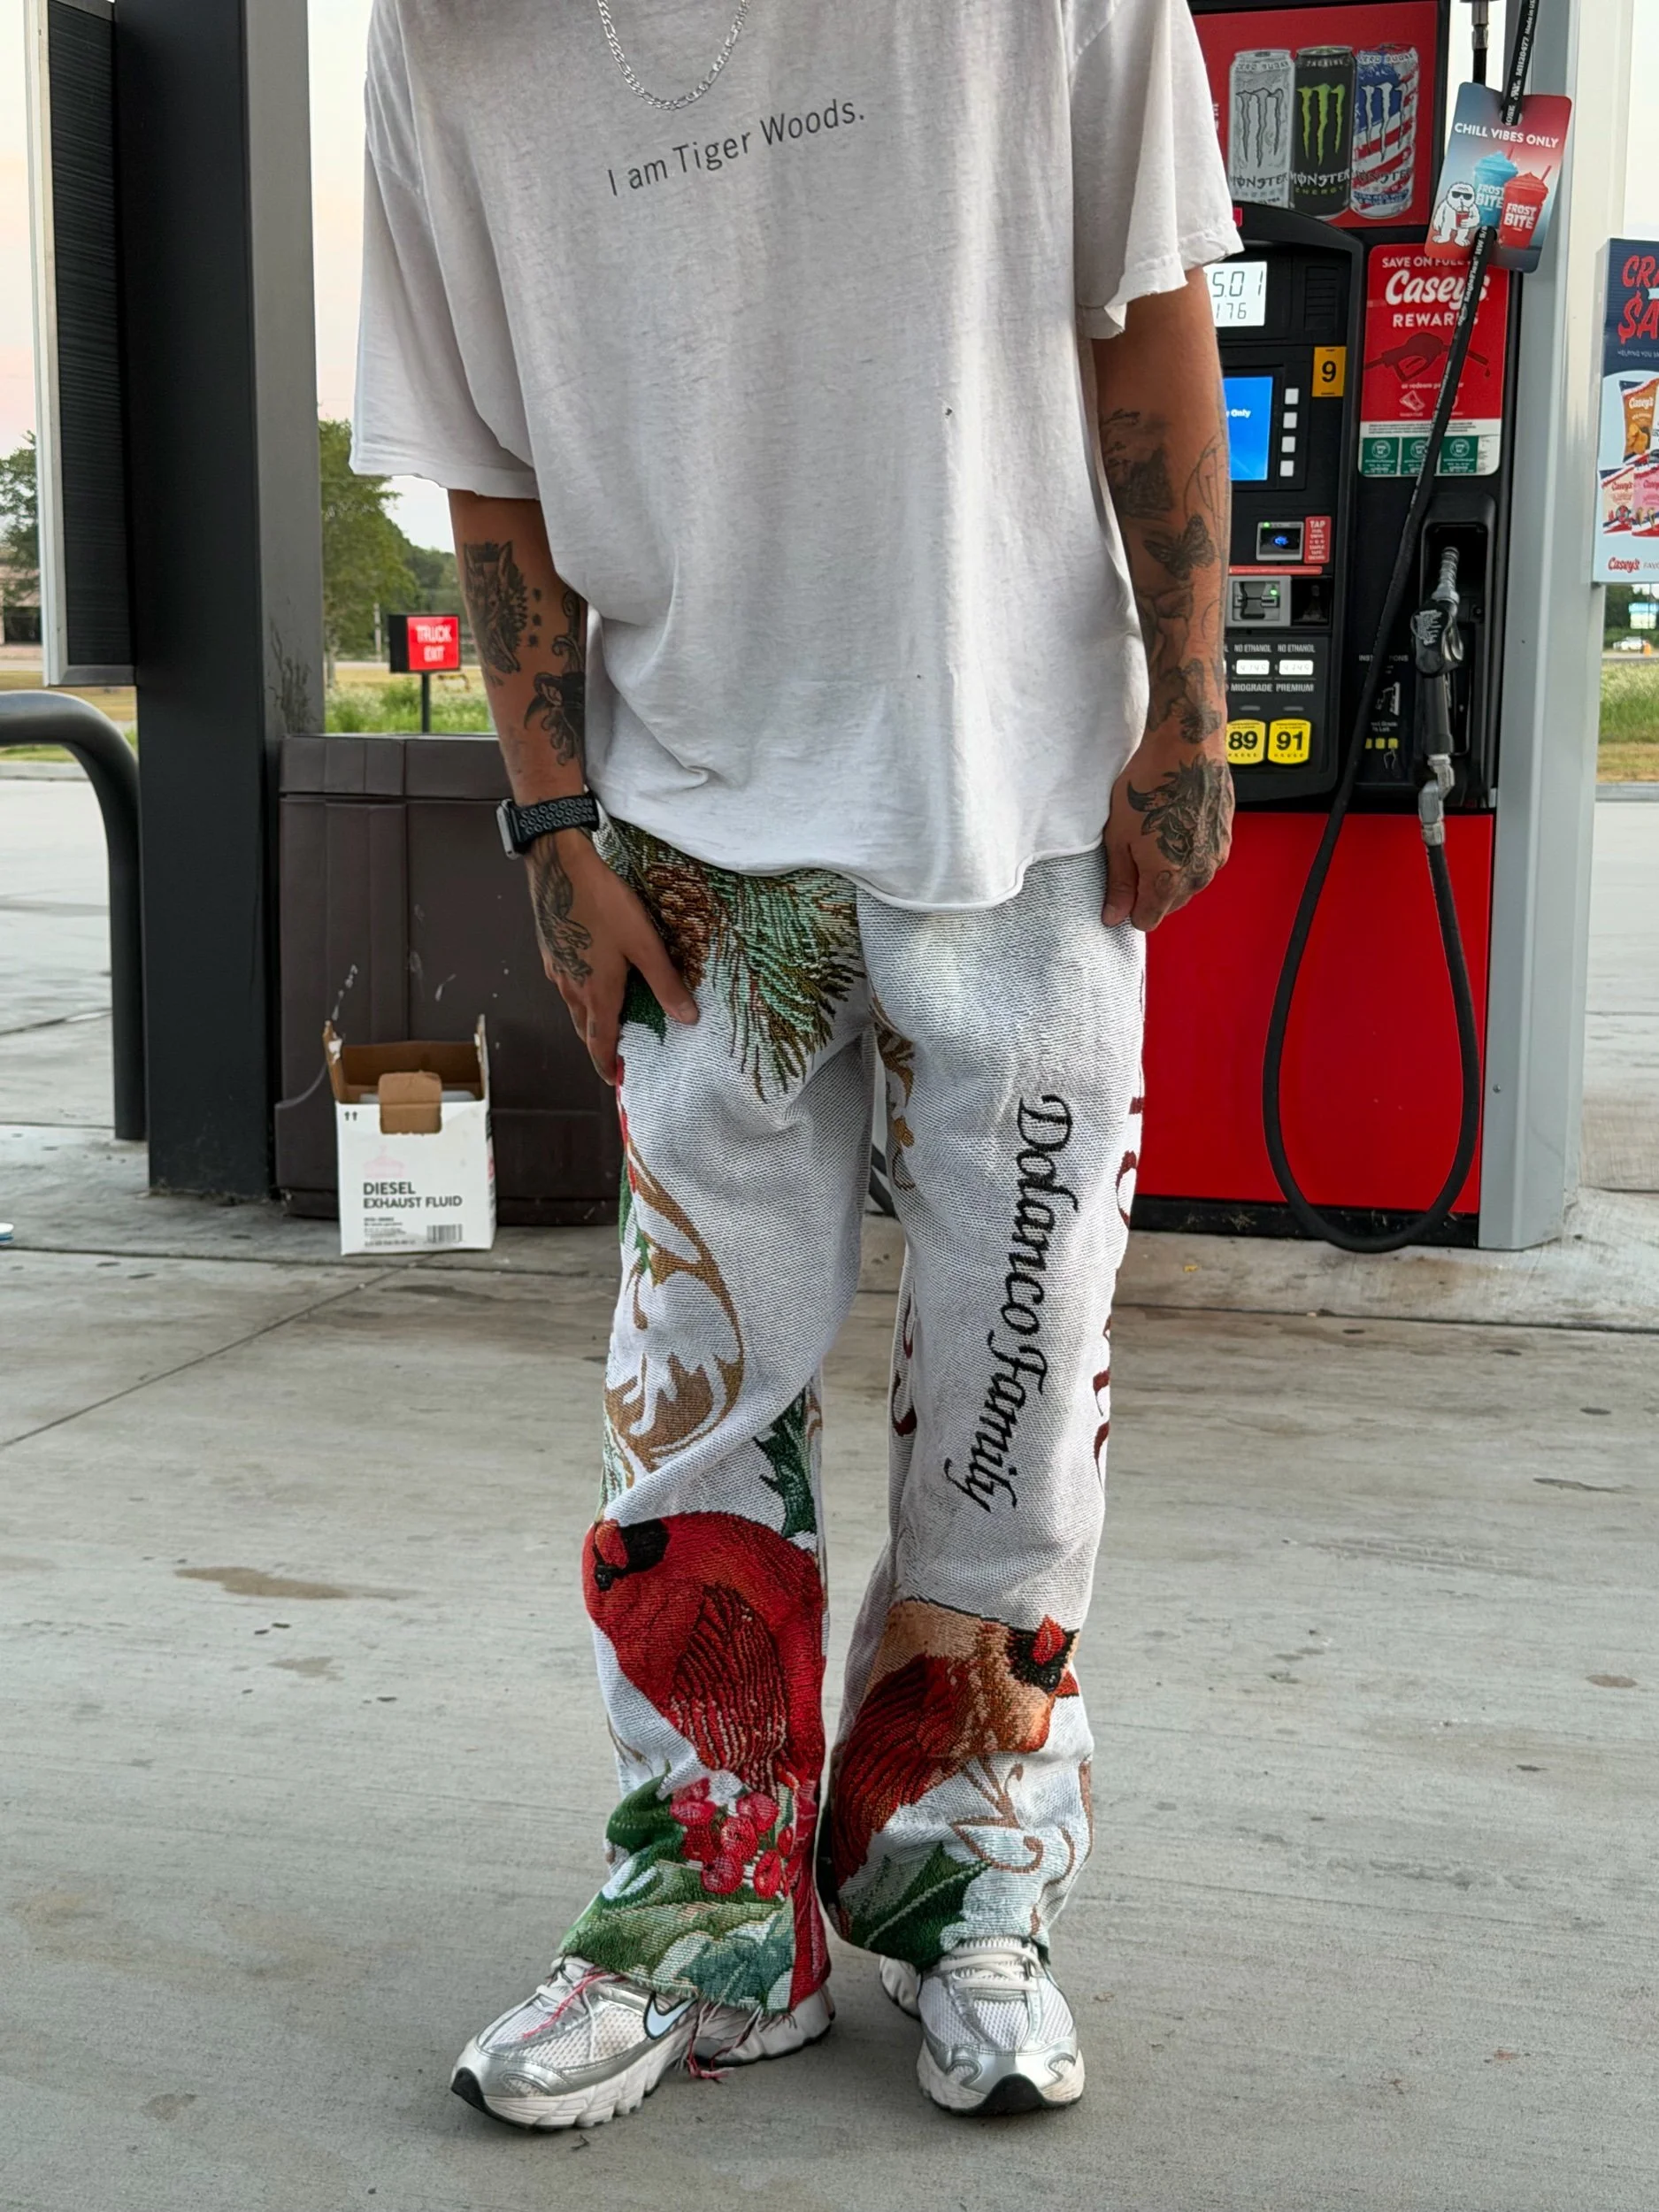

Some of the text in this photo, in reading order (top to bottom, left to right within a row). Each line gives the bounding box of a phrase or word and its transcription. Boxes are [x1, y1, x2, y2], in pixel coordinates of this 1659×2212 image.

[1455, 122, 1559, 149] CHILL VIBES ONLY
[607, 98, 865, 196] I am Tiger Woods.
[1291, 168, 1350, 188] MONSTER
[1477, 184, 1505, 196] FROST
[1475, 194, 1504, 209] BITE
[1506, 204, 1537, 216] FROST
[1504, 213, 1535, 229] BITE
[1382, 257, 1410, 268] SAVE
[1413, 257, 1432, 267] ON
[1321, 361, 1337, 383] 9
[1231, 409, 1251, 419] Only
[1608, 557, 1640, 573] Casey's
[416, 625, 452, 643] TRUCK
[424, 645, 445, 663] EXIT
[1287, 644, 1316, 653] ETHANOL
[1231, 683, 1272, 692] MIDGRADE
[1276, 683, 1314, 692] PREMIUM
[1228, 731, 1258, 750] 89
[1276, 731, 1303, 750] 91
[363, 1181, 416, 1195] DIESEL
[363, 1195, 463, 1210] EXHAUST FLUID
[944, 1329, 1048, 1514] Family
